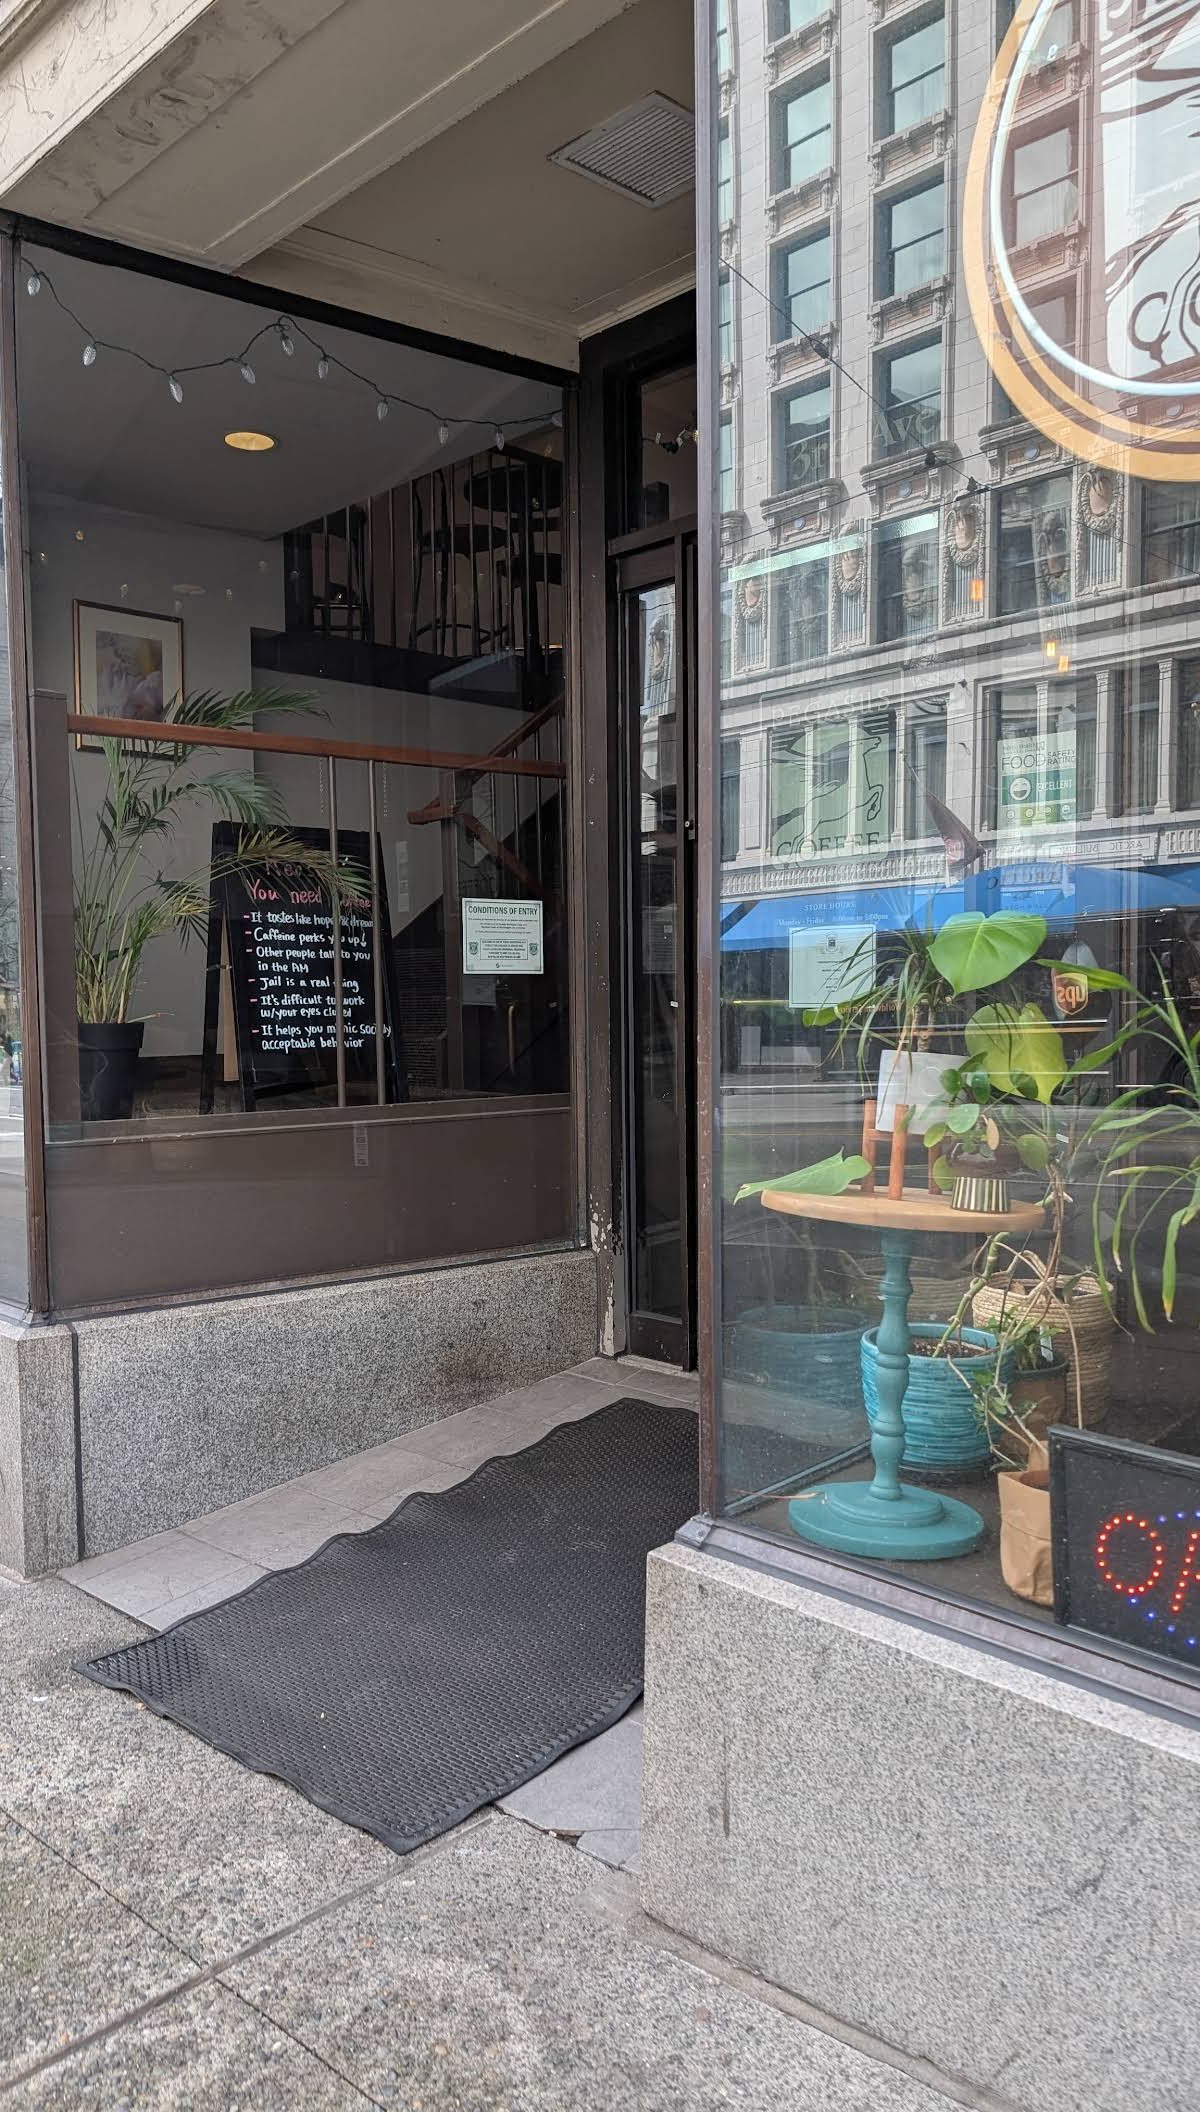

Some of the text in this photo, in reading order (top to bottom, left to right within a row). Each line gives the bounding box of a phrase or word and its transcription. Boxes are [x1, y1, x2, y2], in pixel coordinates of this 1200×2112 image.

[1001, 753, 1046, 771] FOOD
[776, 831, 880, 860] COFFEE
[247, 878, 280, 900] You
[289, 886, 322, 904] need
[251, 912, 263, 923] It
[266, 911, 294, 924] tastes
[296, 912, 312, 925] like
[468, 906, 538, 916] CONDITIONS OF ENTRY
[254, 927, 295, 943] Caffeine
[299, 933, 325, 945] perks
[256, 946, 284, 958] Other
[286, 948, 316, 960] people
[352, 951, 370, 961] you
[258, 961, 309, 973] in the AM
[260, 976, 281, 990] Jail
[286, 978, 295, 987] is
[311, 976, 330, 987] real
[260, 994, 279, 1006] It's
[281, 994, 322, 1006] difficult
[343, 995, 365, 1005] work
[260, 1007, 351, 1020] w/your eyes cloed
[262, 1025, 273, 1036] It
[276, 1024, 301, 1037] helps
[304, 1026, 323, 1036] you
[262, 1036, 365, 1054] acceptable behvior
